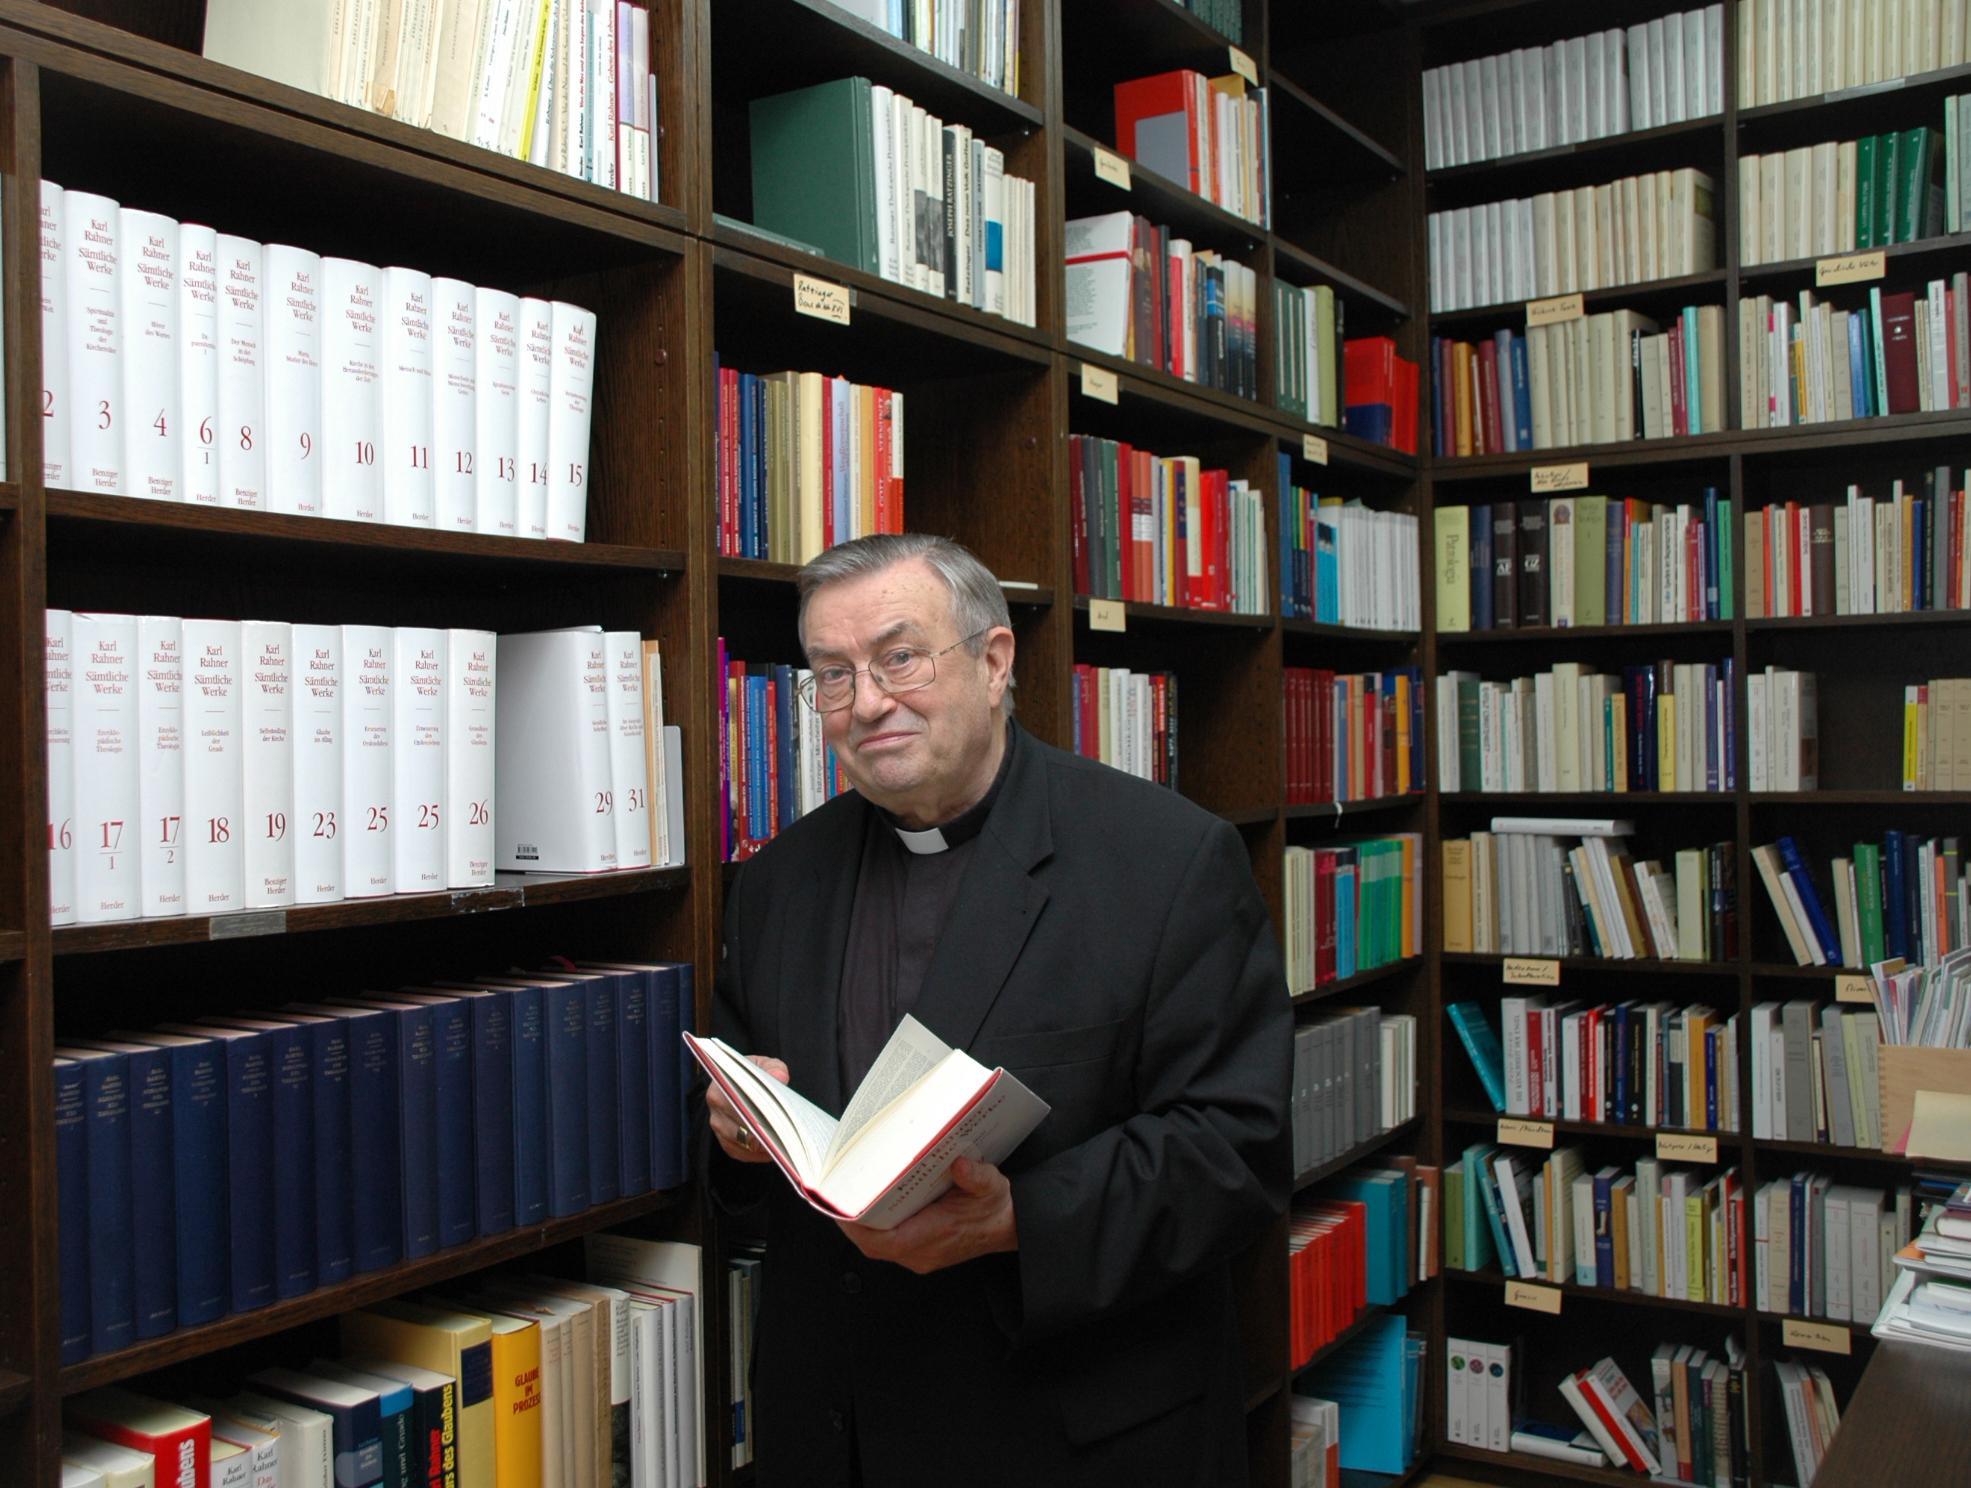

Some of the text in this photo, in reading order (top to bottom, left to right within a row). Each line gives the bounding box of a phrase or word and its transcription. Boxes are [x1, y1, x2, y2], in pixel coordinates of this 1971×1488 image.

[946, 154, 954, 203] RATZINGER
[91, 219, 108, 232] Karl
[85, 230, 113, 246] Rahner
[149, 235, 165, 248] Karl
[78, 247, 118, 264] Sämtliche
[142, 246, 170, 262] Rahner
[196, 250, 212, 262] Karl
[87, 261, 113, 275] Werke
[137, 263, 174, 280] Sämtliche
[189, 261, 216, 275] Rahner
[236, 259, 251, 271] Karl
[144, 276, 170, 290] Werke
[230, 270, 256, 284] Rahner
[296, 271, 310, 283] Karl
[225, 285, 259, 300] Sämtliche
[291, 281, 314, 295] Rahner
[355, 285, 369, 296] Karl
[191, 290, 215, 303] Werke
[350, 294, 373, 308] Rahner
[411, 292, 423, 303] Karl
[232, 297, 255, 311] Werke
[286, 297, 317, 312] Sämtliche
[405, 302, 427, 315] Rahner
[457, 302, 469, 313] Karl
[292, 309, 313, 322] Werke
[499, 311, 510, 321] Karl
[351, 321, 372, 334] Werke
[494, 320, 514, 333] Rahner
[407, 328, 427, 340] Werke
[495, 345, 513, 357] Werke
[43, 390, 54, 418] 2
[98, 400, 111, 429] 3
[153, 408, 168, 437] 4
[199, 416, 212, 445] 6
[240, 425, 252, 450] 8
[299, 432, 311, 460] 9
[204, 451, 210, 465] 1
[355, 441, 374, 465] 10
[410, 445, 429, 469] 11
[456, 451, 473, 475] 12
[498, 456, 515, 482] 13
[530, 461, 548, 486] 14
[568, 463, 583, 487] 15
[196, 493, 217, 504] Herder
[47, 636, 64, 648] Karl
[99, 640, 117, 651] Karl
[160, 640, 176, 651] Karl
[206, 646, 223, 656] Karl
[265, 644, 280, 655] Karl
[315, 649, 330, 659] Karl
[368, 648, 382, 658] Karl
[420, 649, 434, 660] Karl
[591, 651, 602, 660] Karl
[623, 651, 634, 660] Karl
[91, 653, 125, 665] Rahner
[153, 653, 181, 664] Rahner
[200, 657, 228, 668] Rahner
[259, 655, 285, 666] Rahner
[472, 652, 486, 662] Karl
[310, 660, 335, 671] Rahner
[363, 659, 386, 670] Rahner
[415, 660, 439, 672] Rahner
[467, 662, 489, 672] Rahner
[619, 659, 638, 669] Rahner
[85, 671, 129, 682] Sämtliche
[194, 673, 232, 685] Sämtliche
[254, 672, 288, 682] Sämtliche
[304, 676, 338, 687] Sämtliche
[359, 675, 389, 685] Sämtliche
[410, 675, 442, 686] Sämtliche
[463, 677, 492, 687] Sämtliche
[616, 673, 641, 684] Sämtliche
[93, 684, 123, 695] Werke
[155, 682, 180, 693] Werke
[202, 686, 228, 697] Werke
[261, 684, 284, 695] Werke
[311, 688, 334, 698] Werke
[365, 686, 385, 696] Werke
[417, 685, 438, 697] Werke
[469, 687, 488, 697] Werke
[589, 684, 606, 694] Werke
[622, 683, 638, 692] Werke
[594, 791, 613, 815] 29
[627, 787, 645, 812] 31
[417, 804, 440, 831] 25
[468, 799, 489, 825] 26
[312, 811, 336, 839] 23
[366, 806, 388, 833] 25
[47, 817, 72, 850] 16
[159, 816, 181, 844] 17
[207, 816, 230, 843] 18
[265, 812, 286, 842] 19
[100, 820, 124, 849] 17
[109, 855, 115, 870] 1
[167, 850, 175, 864] 2
[267, 885, 286, 895] Herder
[159, 894, 181, 903] Herder
[208, 893, 230, 902] Herder
[101, 901, 124, 910] Herder
[960, 1095, 1006, 1138] Werke
[514, 1366, 540, 1388] GLAUBE
[524, 1383, 534, 1397] IM
[513, 1391, 541, 1416] PROZES
[441, 1384, 454, 1471] des Glaubens
[257, 1448, 274, 1461] Karl
[429, 1427, 441, 1477] Rahner
[227, 1463, 242, 1475] Karl
